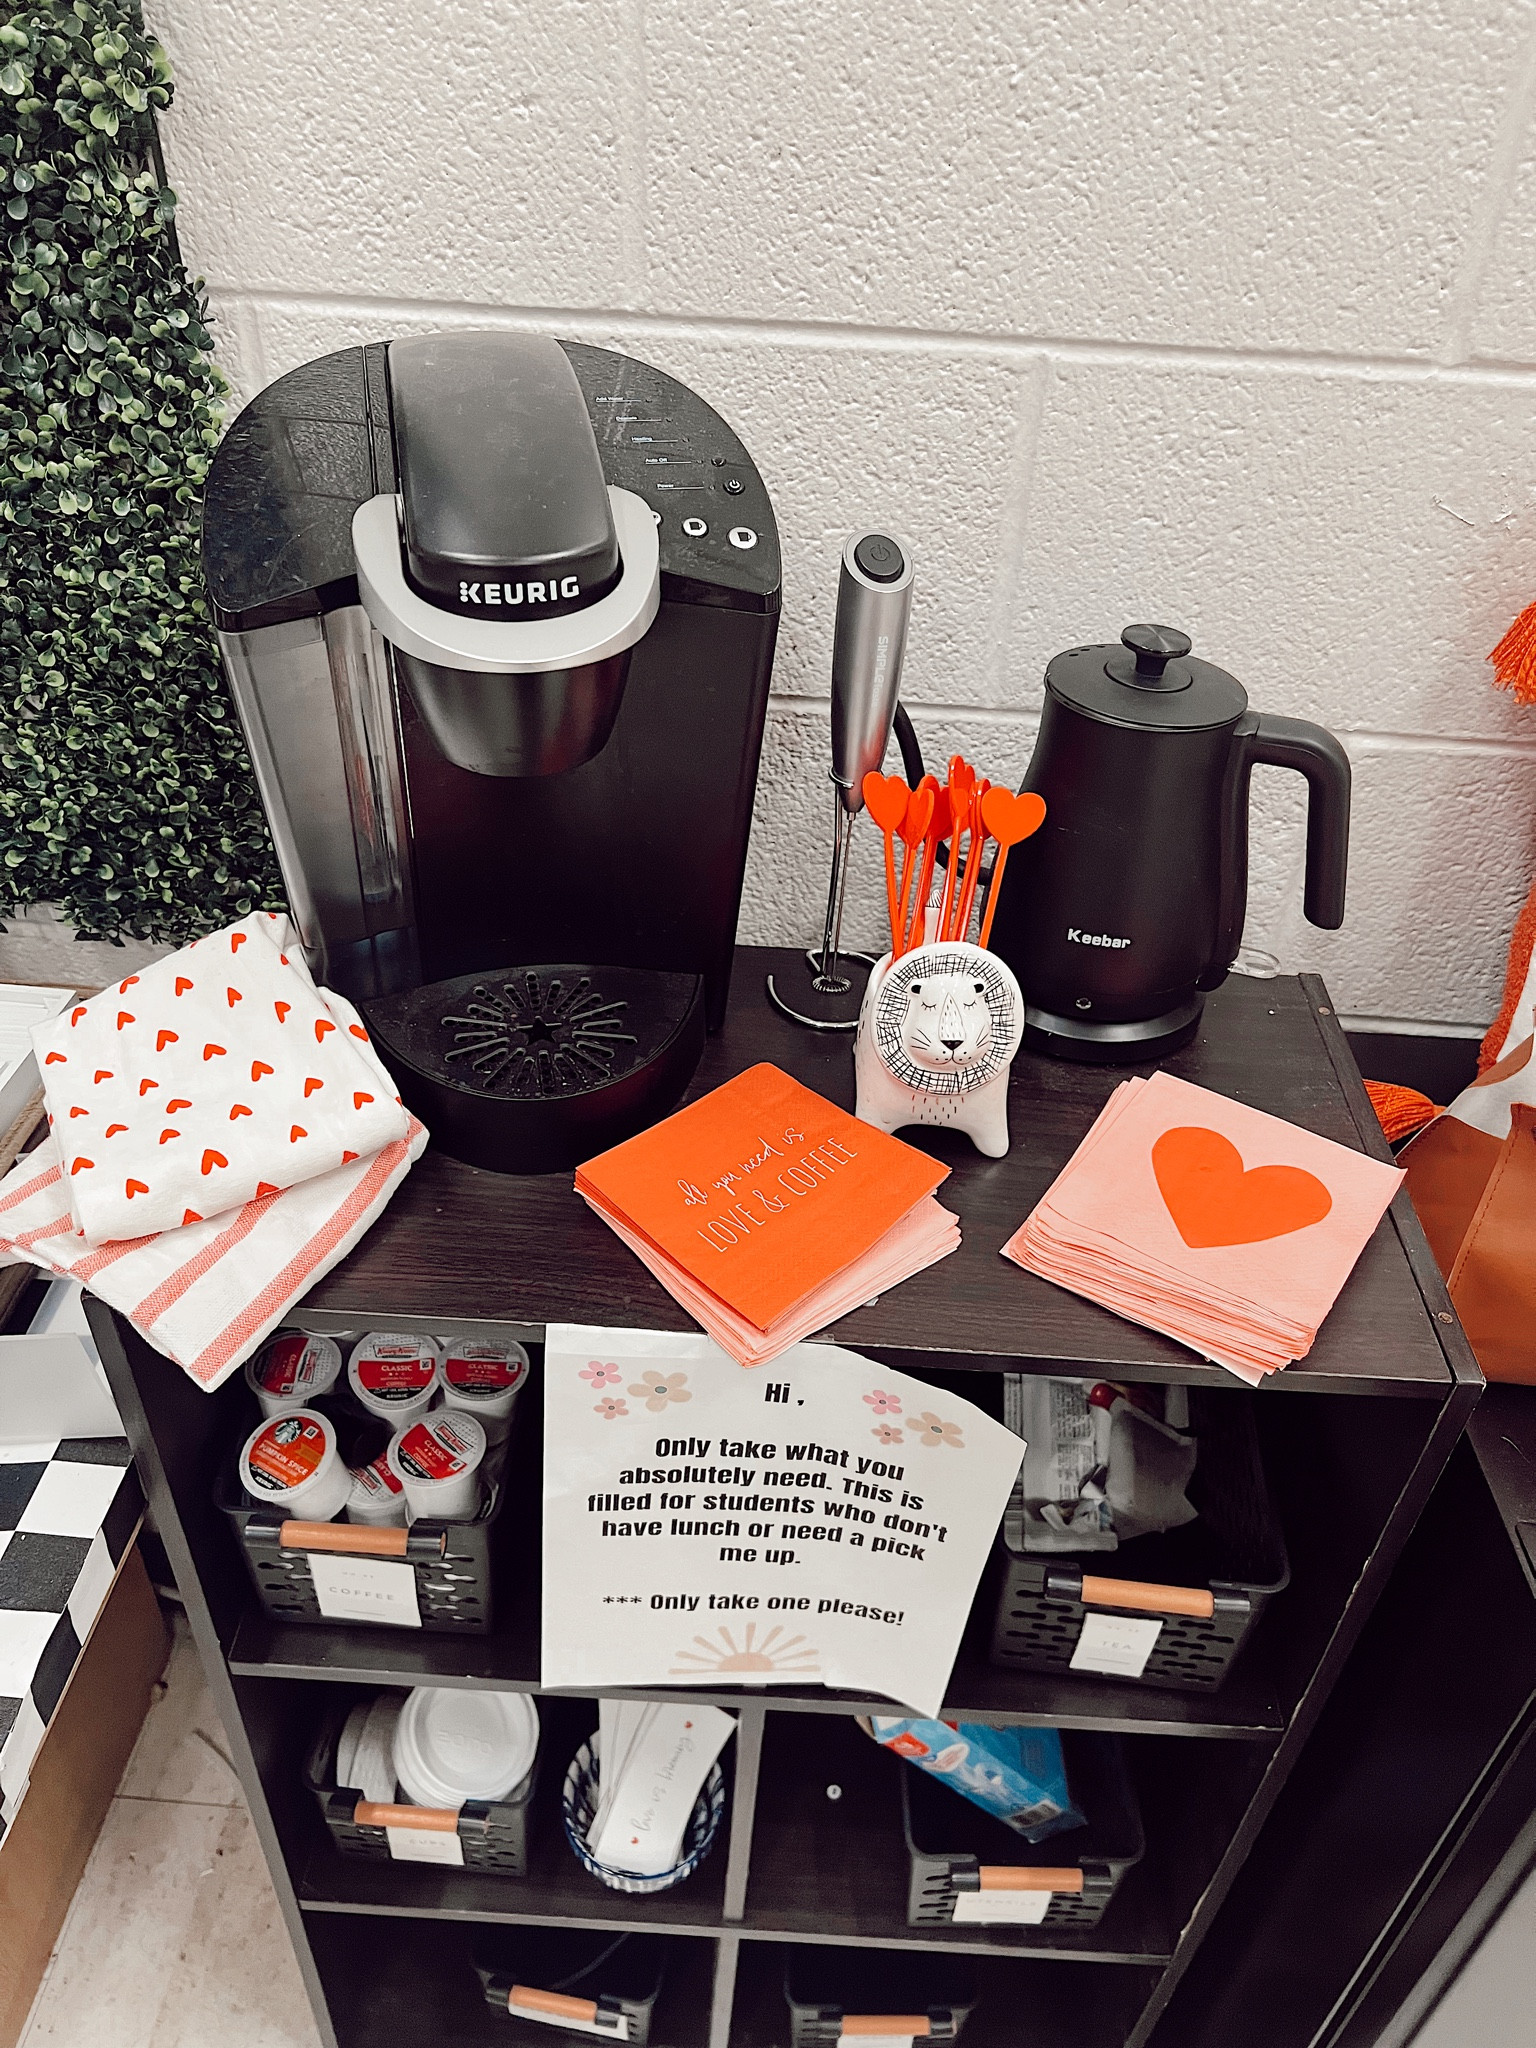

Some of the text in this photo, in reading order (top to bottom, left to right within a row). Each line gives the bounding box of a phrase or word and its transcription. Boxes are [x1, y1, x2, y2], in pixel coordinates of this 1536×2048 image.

[459, 575, 580, 605] KEURIG
[1067, 928, 1131, 949] Keebar
[677, 1127, 805, 1205] all you need is
[697, 1137, 858, 1253] LOVE & COFFEE
[764, 1382, 791, 1404] Hi
[287, 1460, 309, 1476] SPICE
[655, 1437, 905, 1481] Only take what you
[619, 1465, 924, 1513] absolutely need. This is
[587, 1492, 948, 1543] filled for students who don't
[602, 1518, 926, 1561] have lunch or need a pick
[719, 1547, 801, 1566] me up.
[328, 1586, 395, 1600] COFFEE
[650, 1594, 700, 1613] Only
[708, 1593, 760, 1610] take
[767, 1597, 811, 1611] one
[817, 1598, 905, 1626] please!
